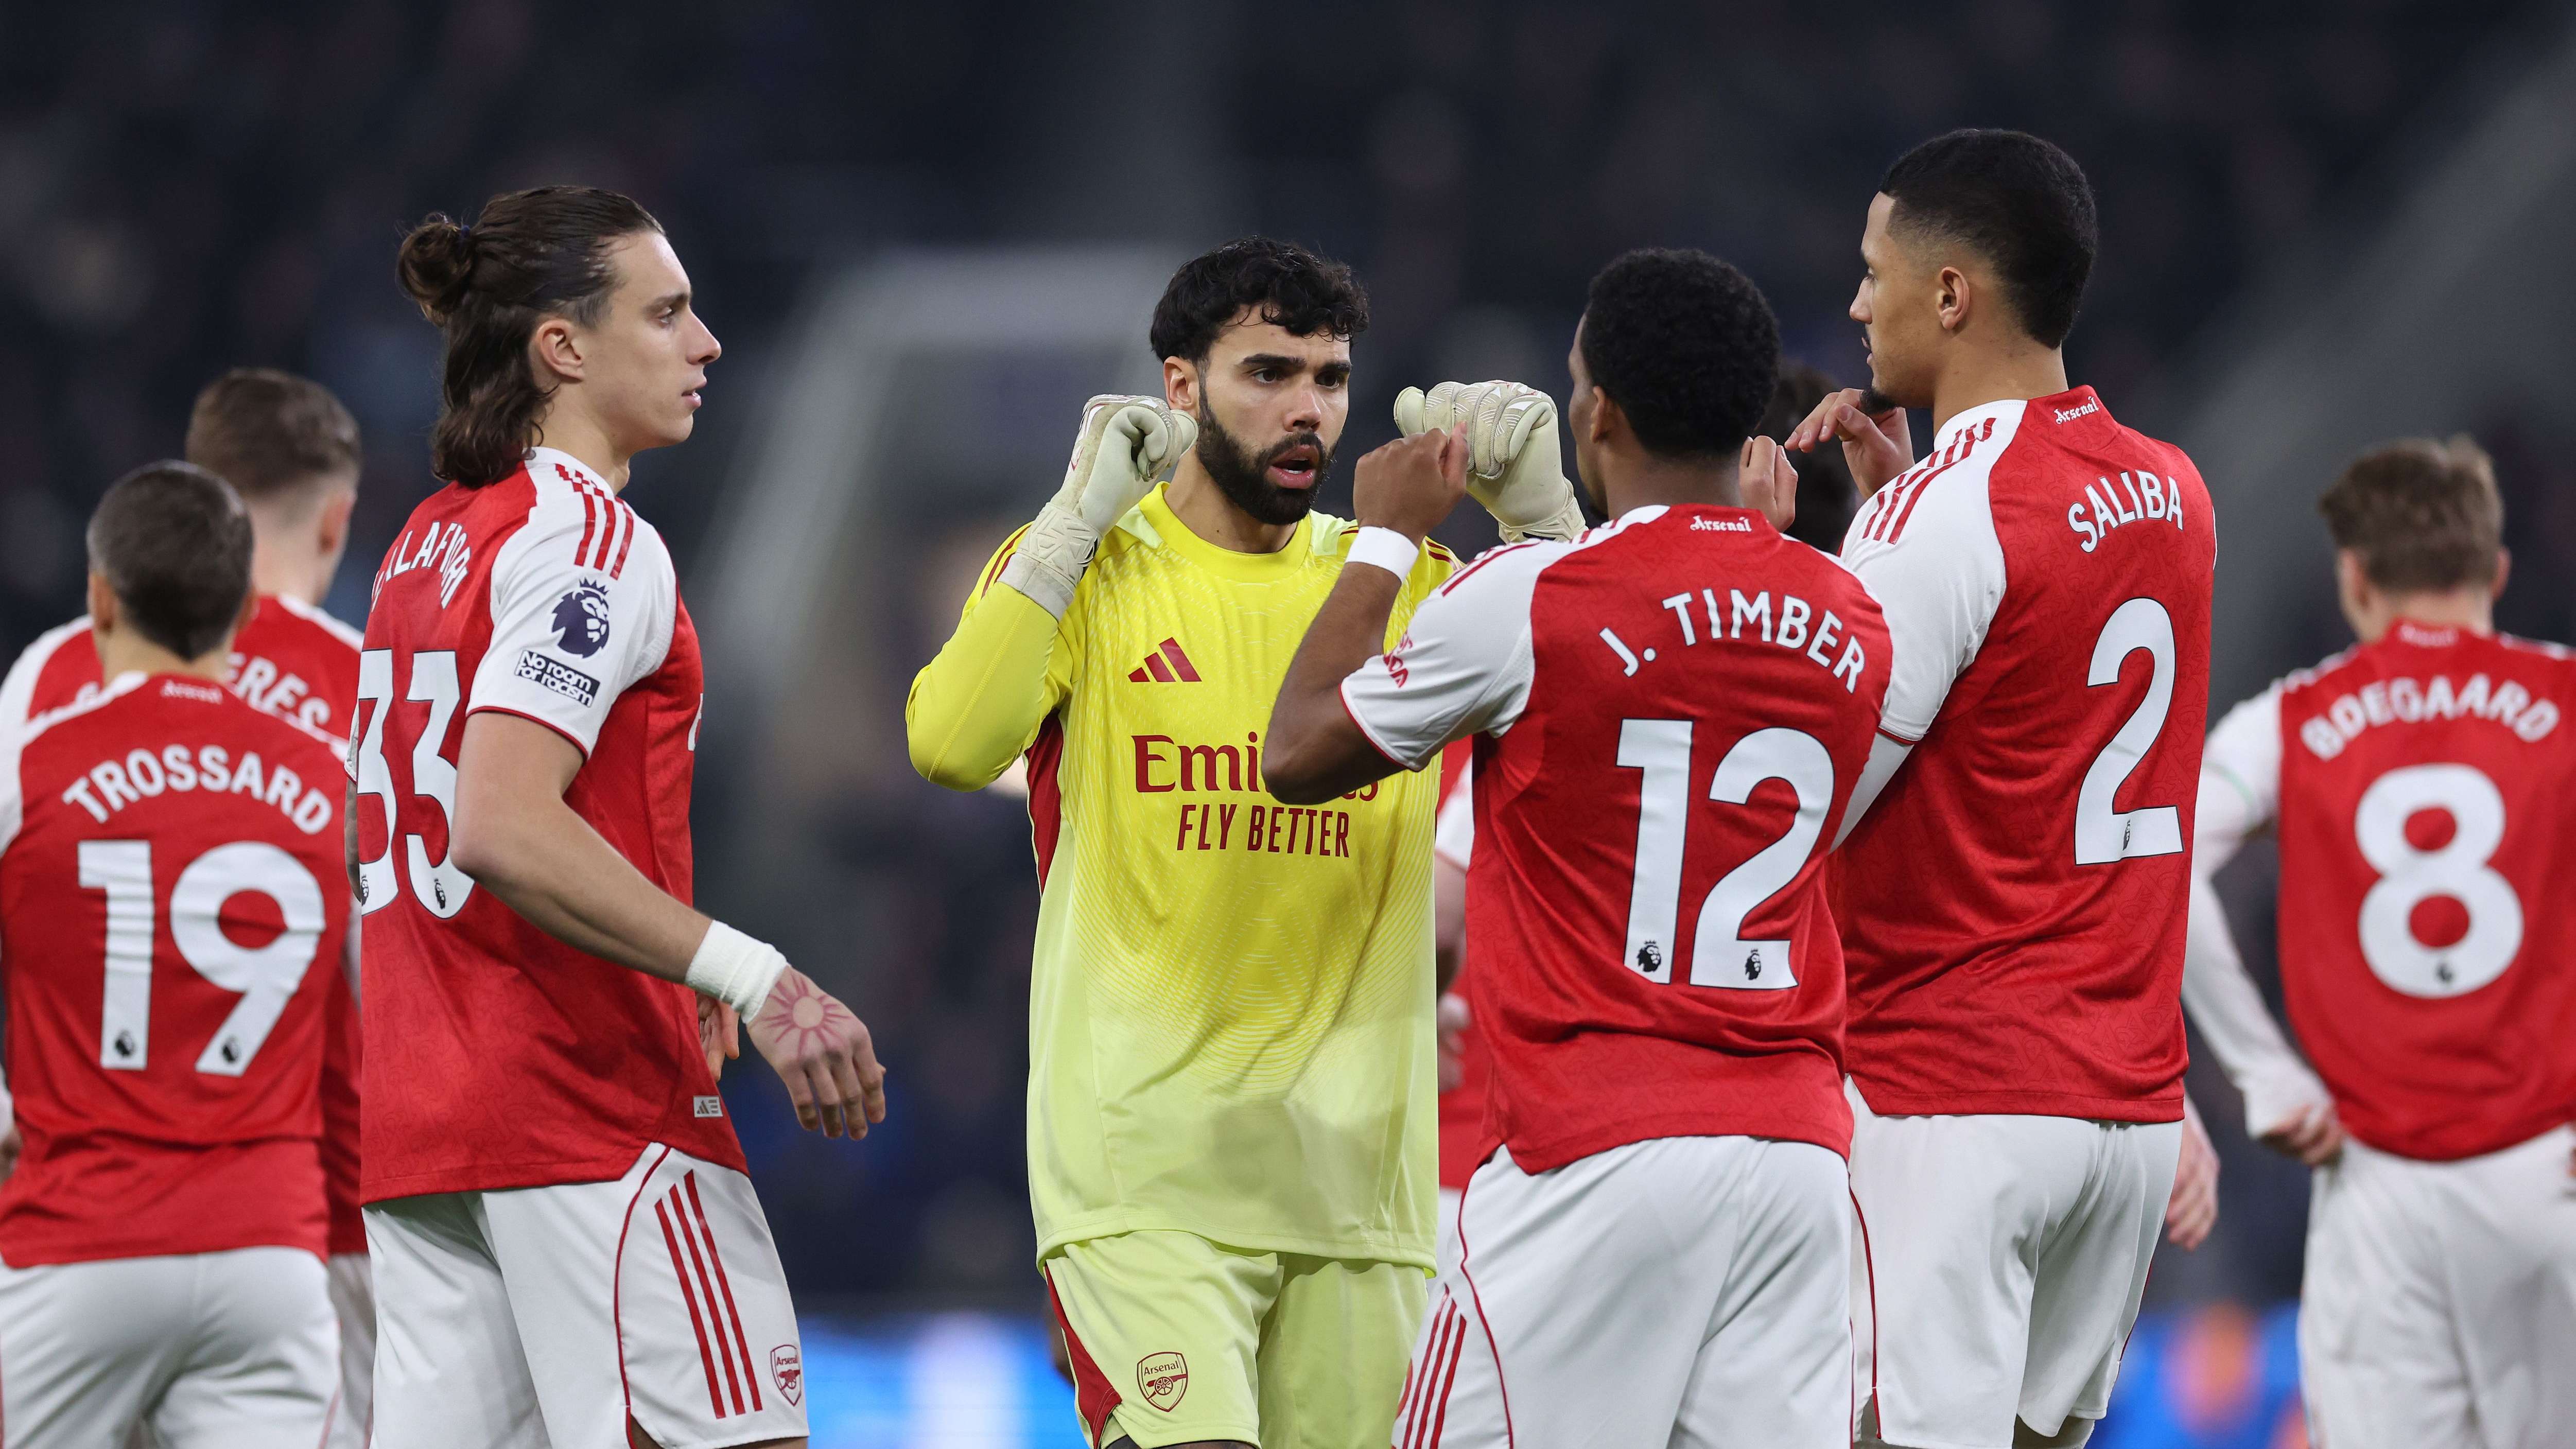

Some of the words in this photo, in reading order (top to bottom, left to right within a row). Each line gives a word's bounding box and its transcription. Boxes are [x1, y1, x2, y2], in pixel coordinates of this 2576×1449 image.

[2053, 395, 2099, 425] Arsenal
[1690, 515, 1752, 532] Arsenal
[2068, 470, 2184, 554] SALIBA
[519, 651, 546, 670] No
[546, 662, 591, 692] room
[1599, 626, 1657, 677] J.
[1663, 588, 1865, 694] TIMBER
[516, 662, 542, 680] for
[541, 673, 593, 707] racism
[2075, 596, 2184, 866] 2
[62, 744, 333, 834] TROSSARD
[1177, 804, 1237, 851] FLY
[1247, 805, 1349, 858] BETTER
[1616, 718, 1835, 990] 12
[2355, 762, 2525, 999] 8
[78, 840, 325, 1077] 19
[1144, 1360, 1179, 1376] Arsenal
